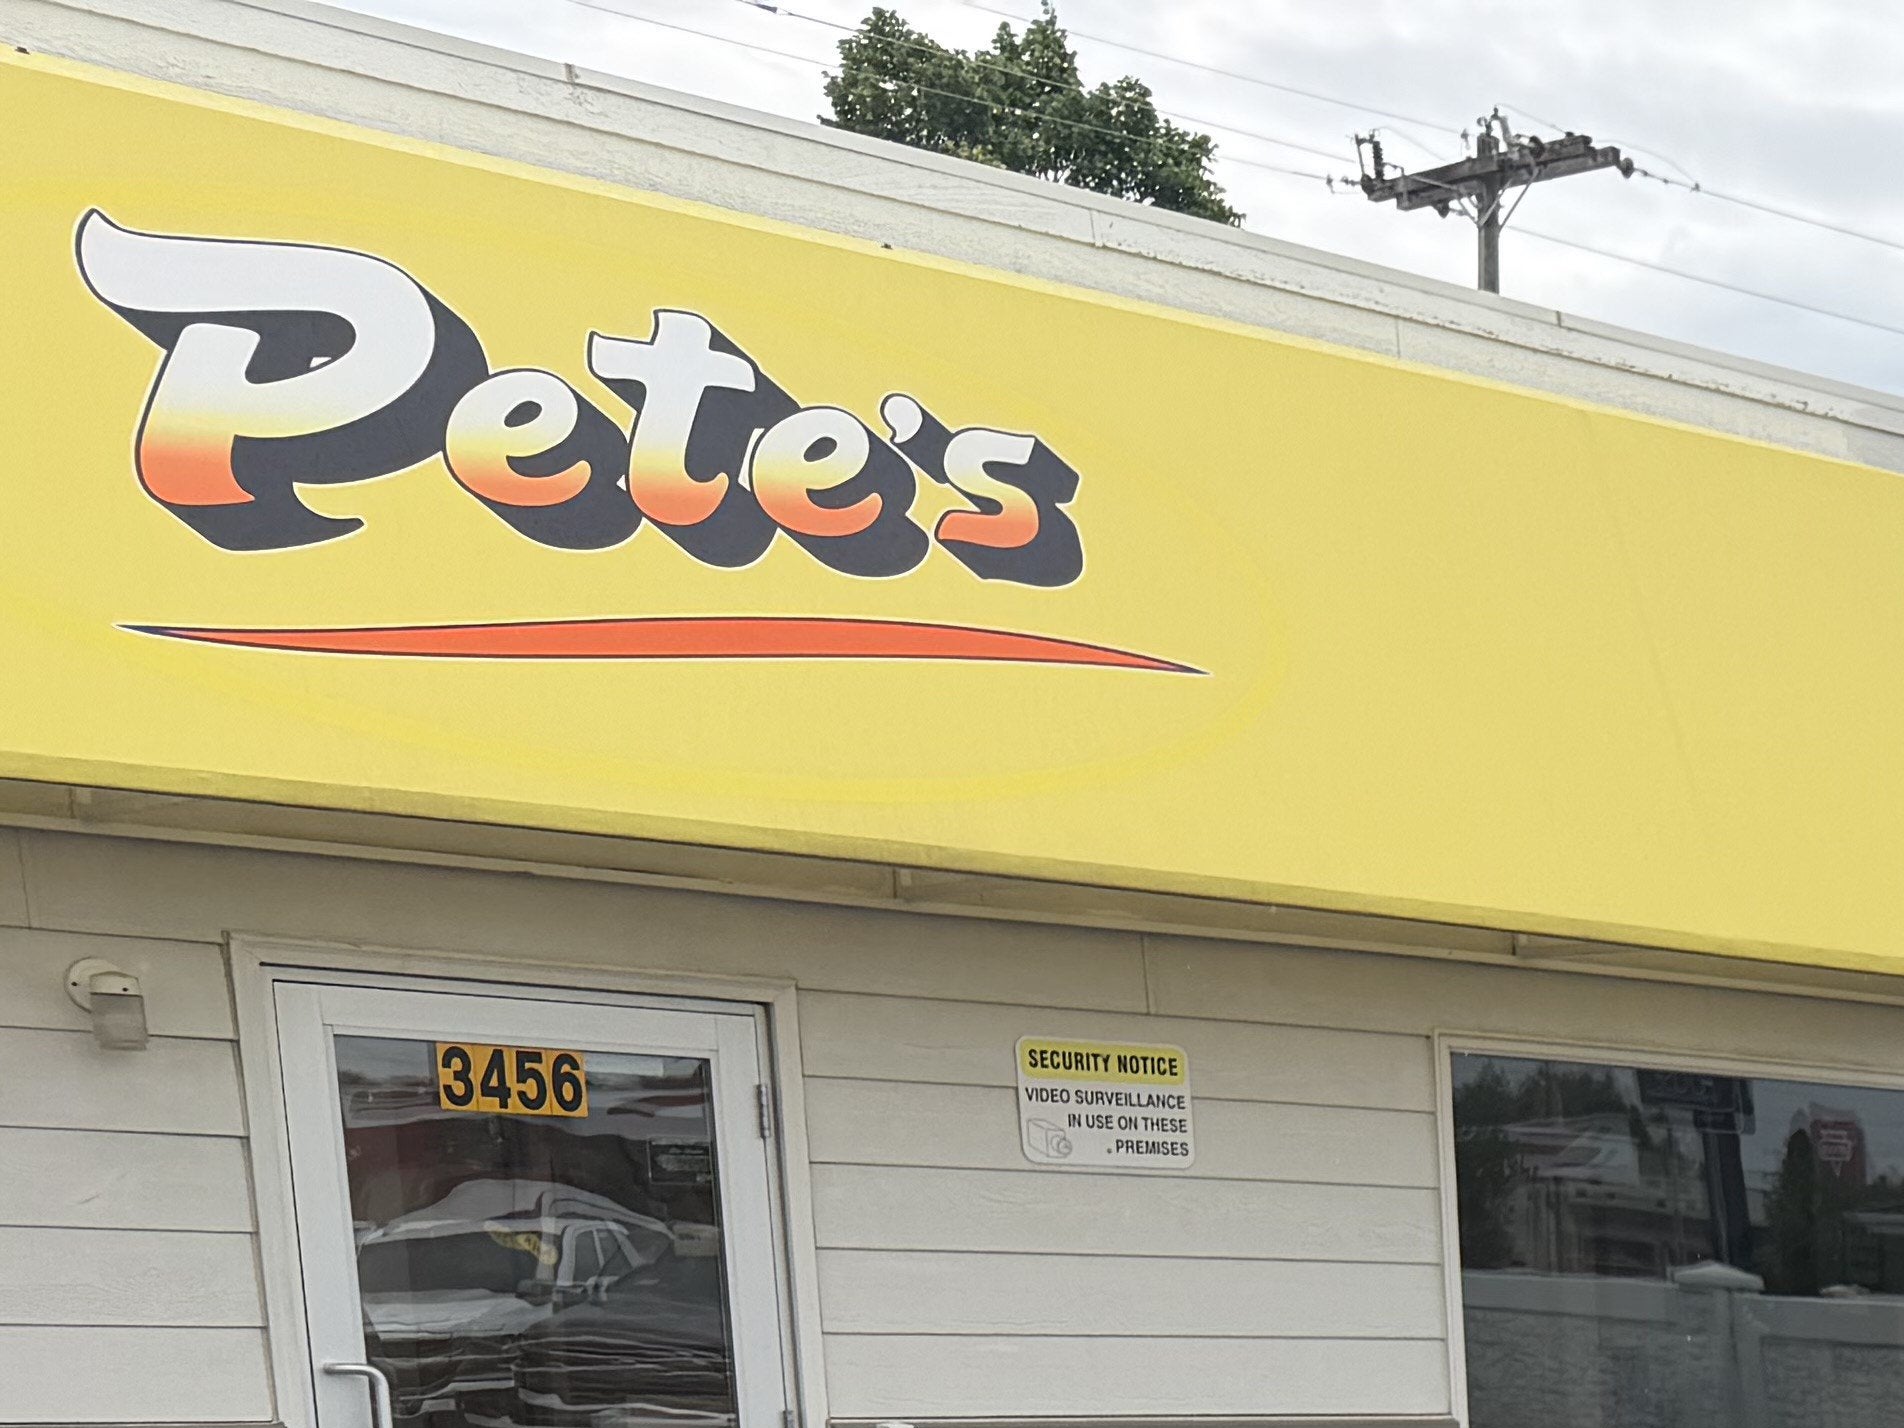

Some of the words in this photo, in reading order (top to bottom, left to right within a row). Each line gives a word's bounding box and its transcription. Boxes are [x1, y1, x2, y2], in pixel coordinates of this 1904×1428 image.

[75, 207, 1084, 588] Pete's
[1028, 1049, 1111, 1072] SECURITY
[1117, 1054, 1178, 1076] NOTICE
[441, 1045, 583, 1112] 3456
[1025, 1087, 1070, 1103] VIDEO
[1075, 1090, 1186, 1110] SURVEILLANCE
[1068, 1114, 1082, 1128] IN
[1086, 1114, 1114, 1130] USE
[1117, 1116, 1138, 1130] ON
[1141, 1117, 1188, 1133] THESE
[1115, 1139, 1189, 1156] PREMISES
